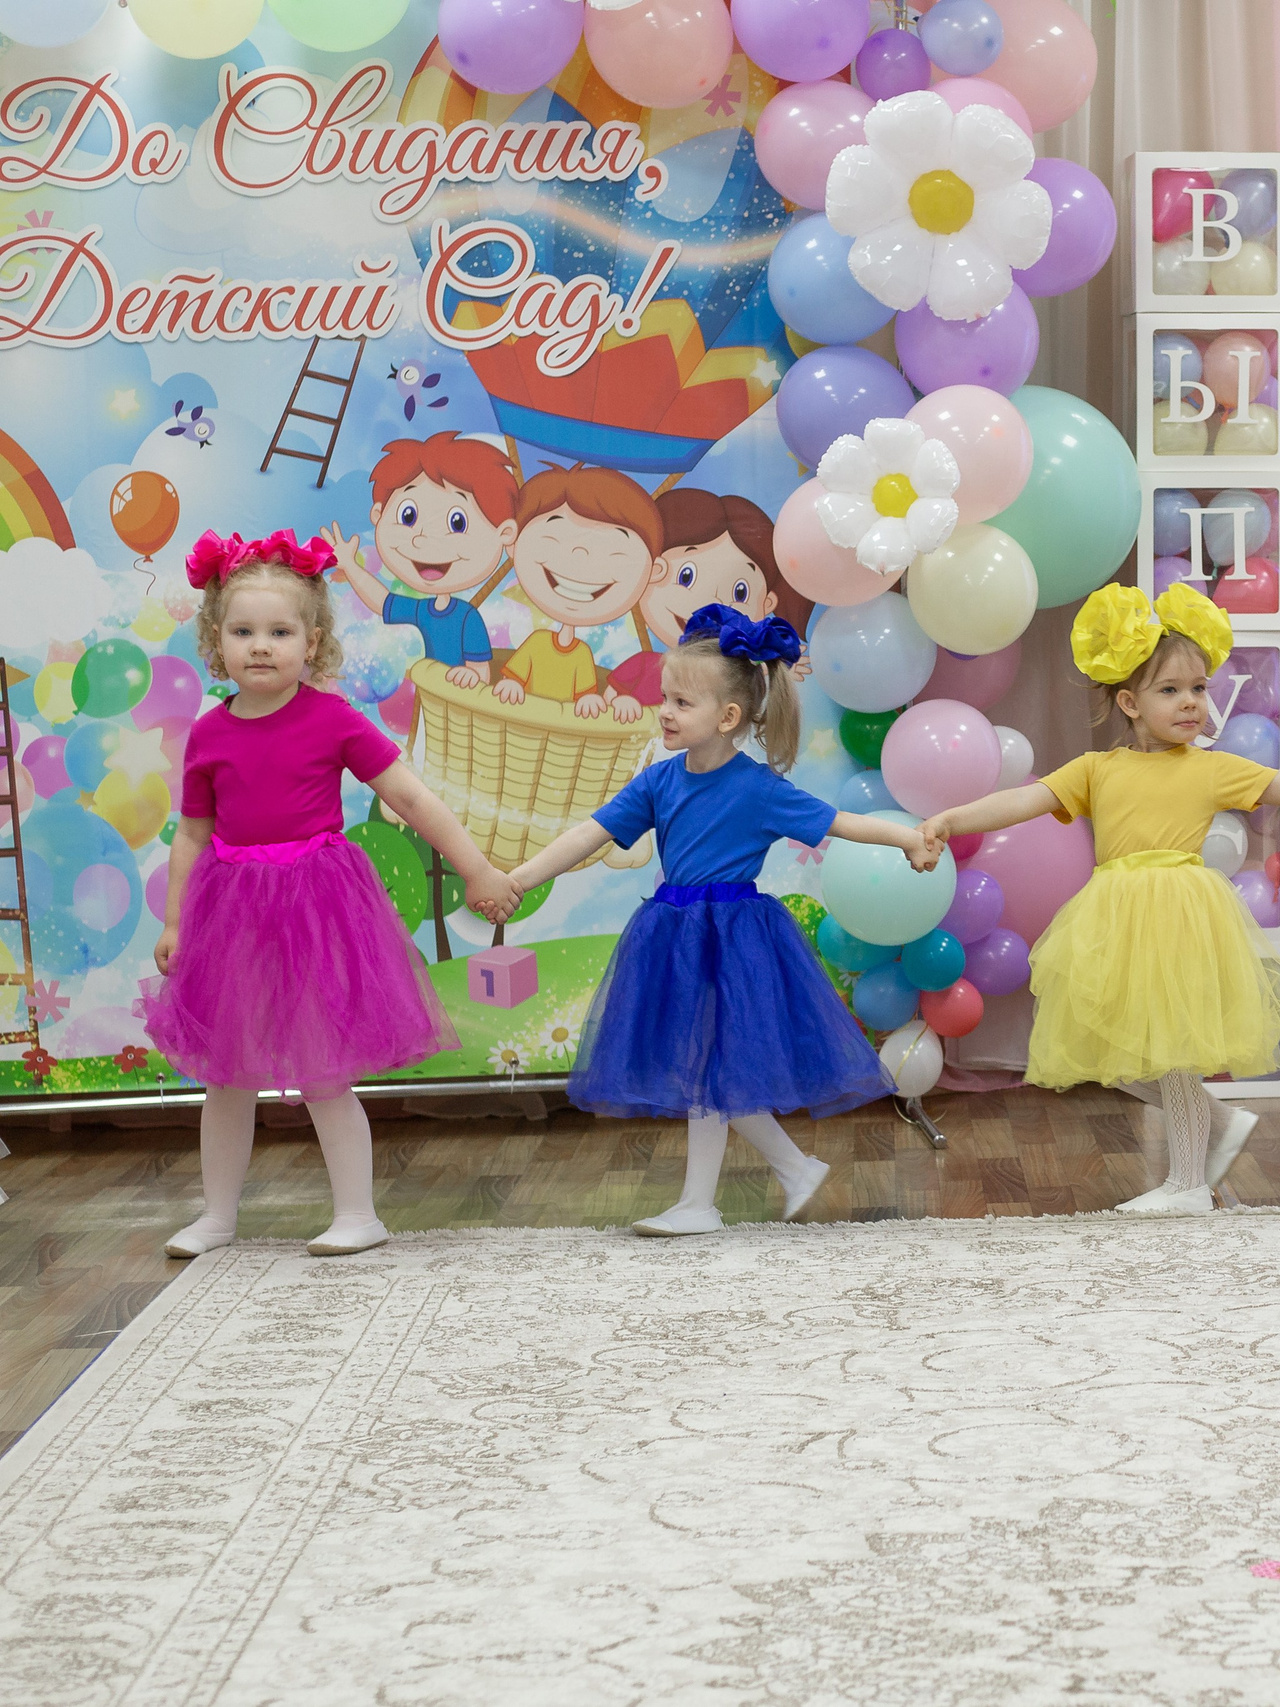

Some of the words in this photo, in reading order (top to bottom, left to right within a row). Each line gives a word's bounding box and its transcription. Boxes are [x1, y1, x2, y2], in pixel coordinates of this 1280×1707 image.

[0, 72, 183, 184] До
[213, 64, 662, 216] Свидания,
[1182, 187, 1243, 263] В
[0, 230, 396, 342] Детский
[425, 224, 675, 369] Сад!
[1160, 349, 1261, 425] Ы
[1179, 506, 1257, 582] П
[480, 968, 495, 998] 1
